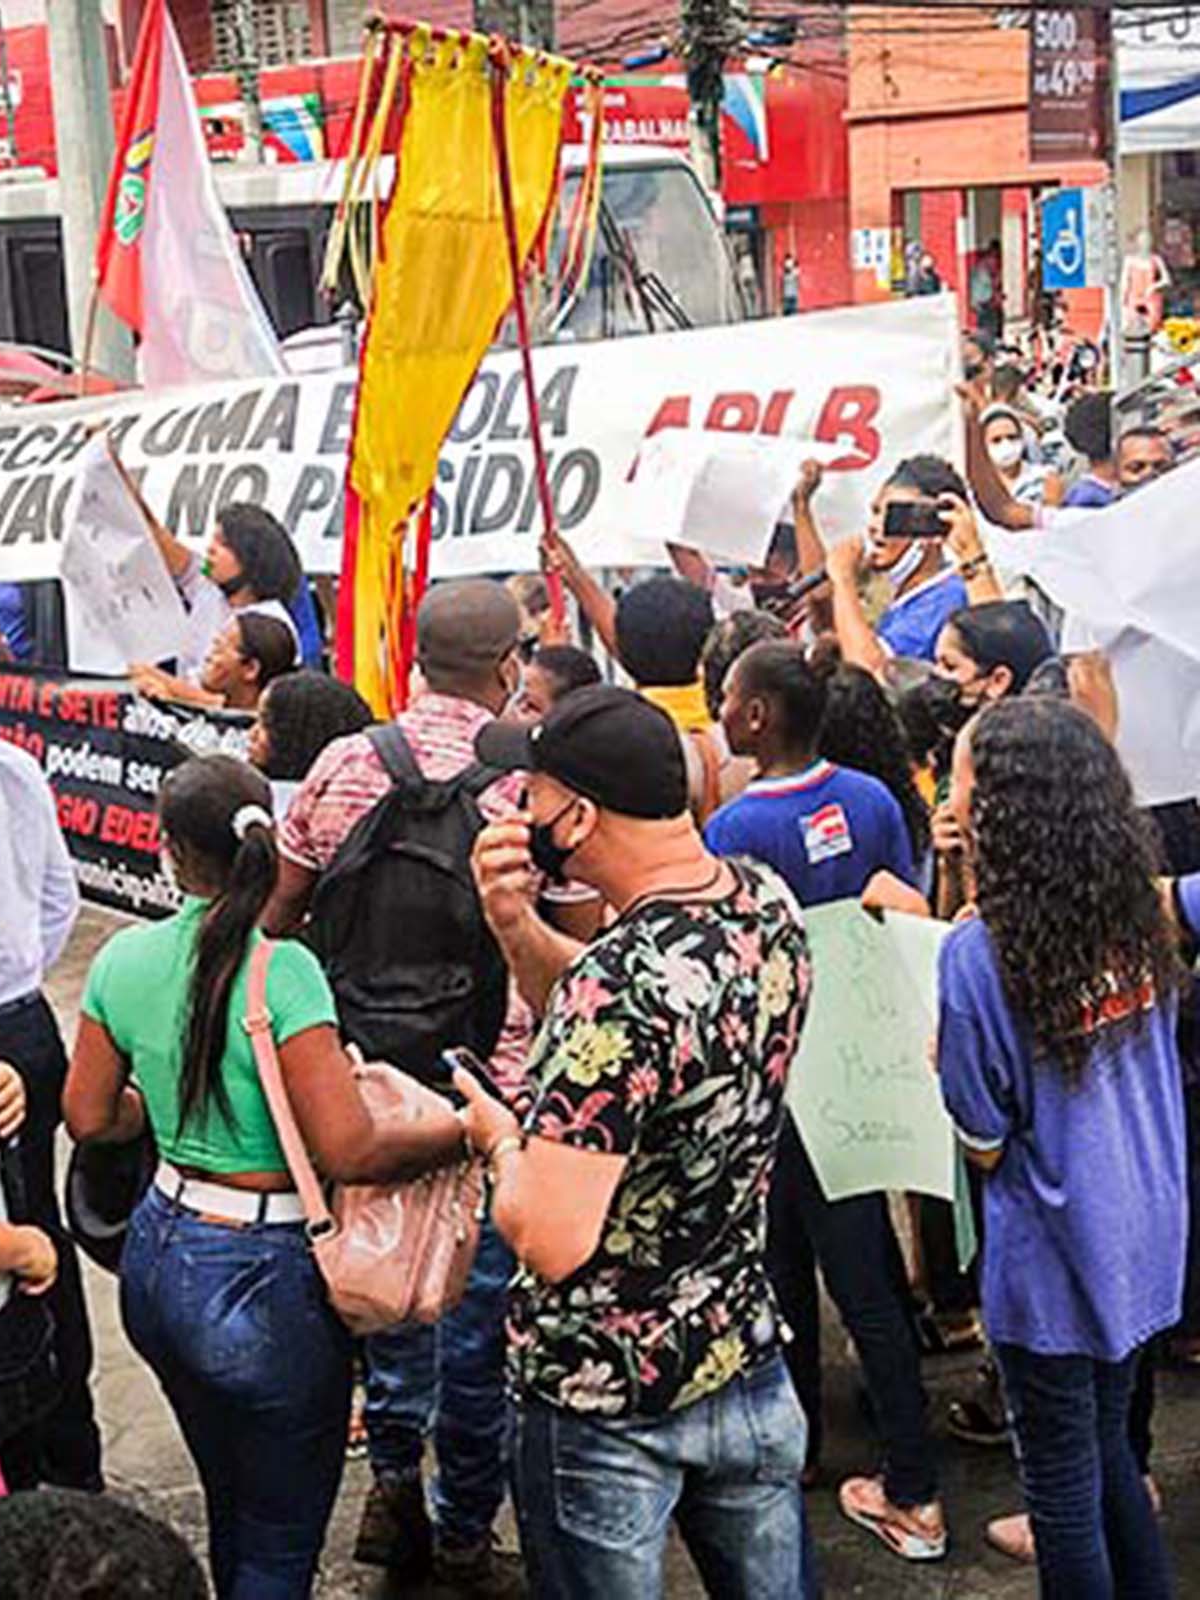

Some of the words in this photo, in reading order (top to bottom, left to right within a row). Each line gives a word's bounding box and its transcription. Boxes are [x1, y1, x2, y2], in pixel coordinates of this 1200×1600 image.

[140, 382, 299, 457] UMA
[317, 365, 579, 455] EOLA
[58, 690, 119, 730] SETE
[45, 741, 123, 788] podem
[125, 761, 161, 797] ser
